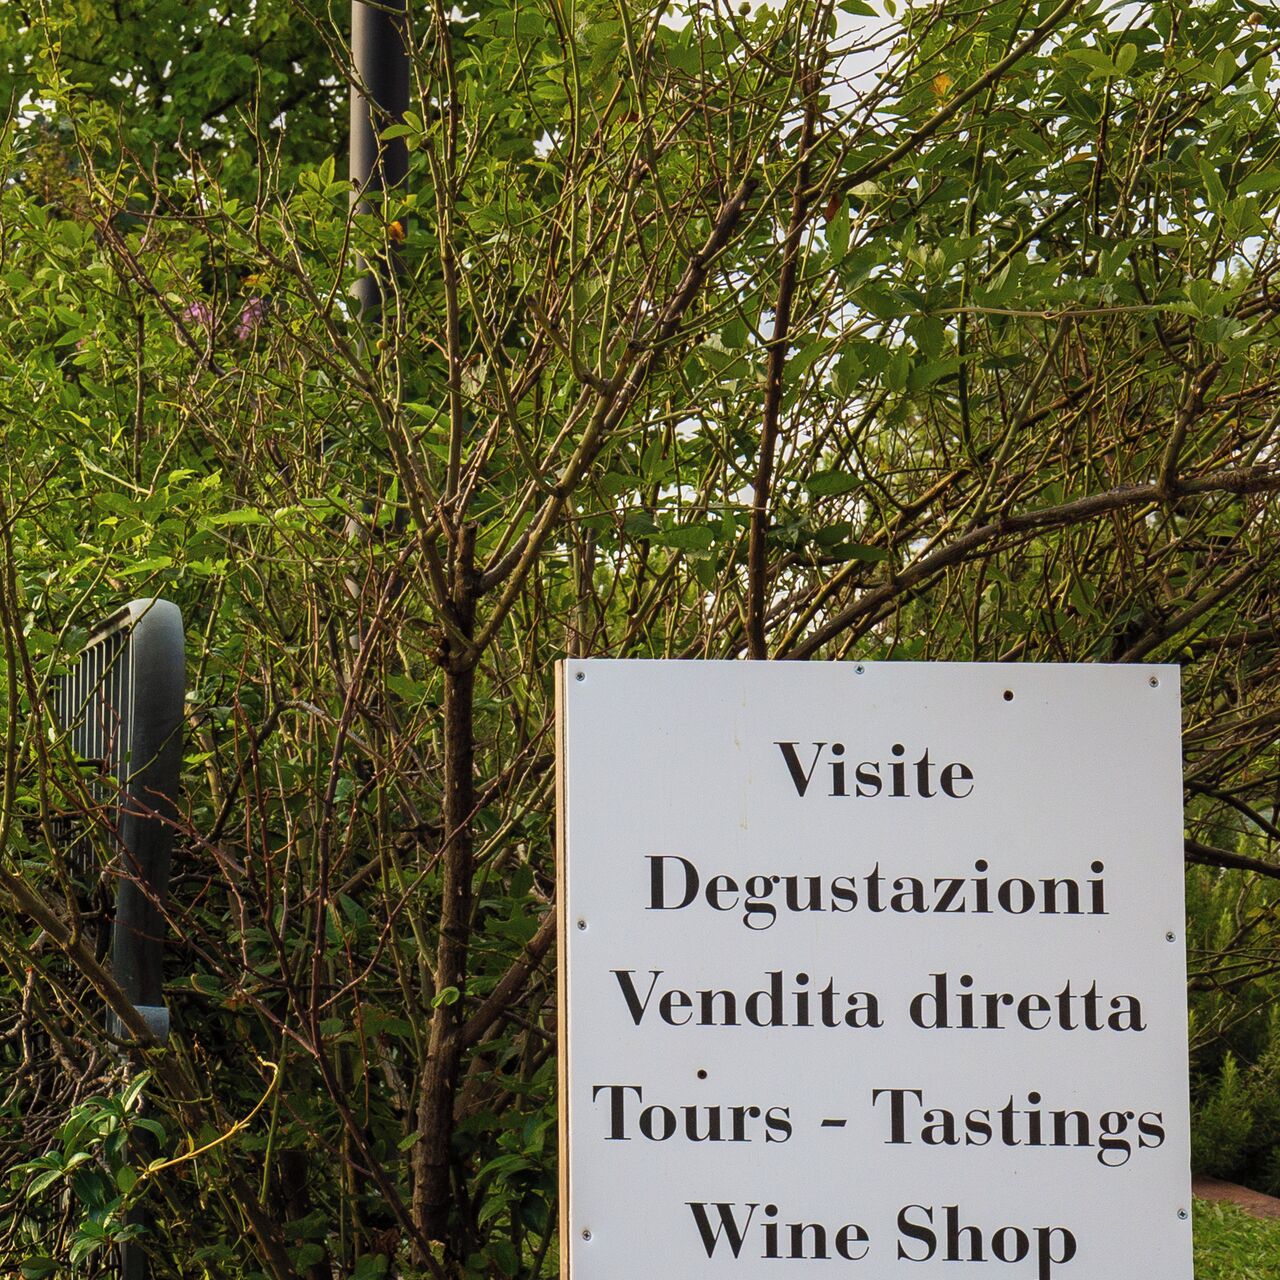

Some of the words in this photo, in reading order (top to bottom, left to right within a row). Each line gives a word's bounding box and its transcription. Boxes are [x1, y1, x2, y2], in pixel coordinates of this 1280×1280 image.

[773, 742, 975, 799] Visite
[644, 855, 1111, 930] Degustazioni
[612, 970, 883, 1030] Vendita
[909, 972, 1148, 1033] diretta
[592, 1085, 793, 1144] Tours
[872, 1089, 1166, 1168] Tastings
[684, 1202, 871, 1261] Wine
